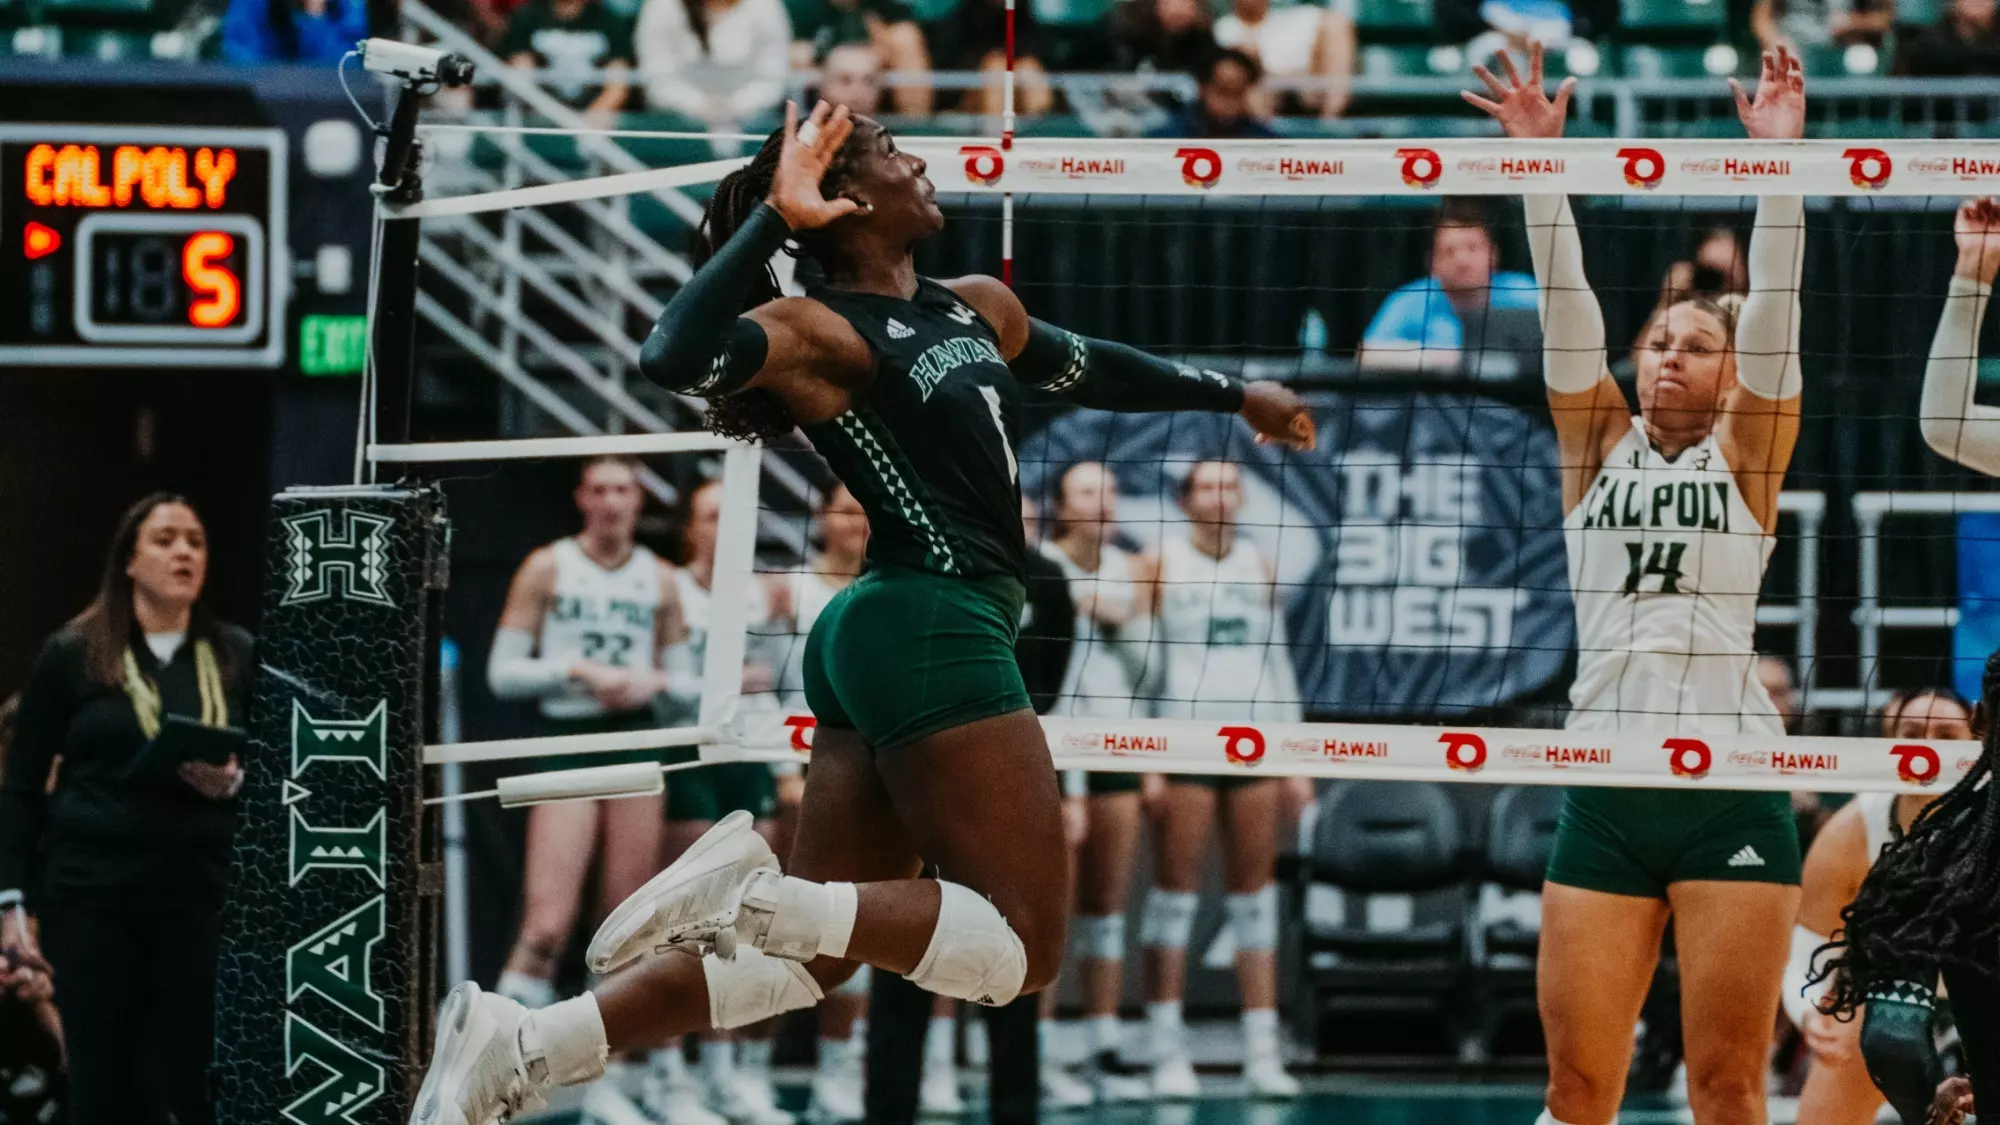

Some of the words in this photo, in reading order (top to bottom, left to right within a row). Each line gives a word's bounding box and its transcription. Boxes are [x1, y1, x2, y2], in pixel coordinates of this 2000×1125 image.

[1061, 157, 1124, 174] HAWAII
[1280, 158, 1344, 175] HAWAII
[1501, 157, 1565, 174] HAWAII
[1724, 158, 1790, 175] HAWAII
[182, 231, 240, 328] 5
[1334, 453, 1480, 520] THE
[1337, 520, 1464, 585] BIG
[1624, 542, 1688, 598] 14
[1330, 587, 1529, 655] WEST
[1104, 733, 1168, 751] HAWAII
[1324, 739, 1388, 757] HAWAII
[1546, 745, 1611, 764] HAWAII
[1772, 751, 1838, 770] HAWAII
